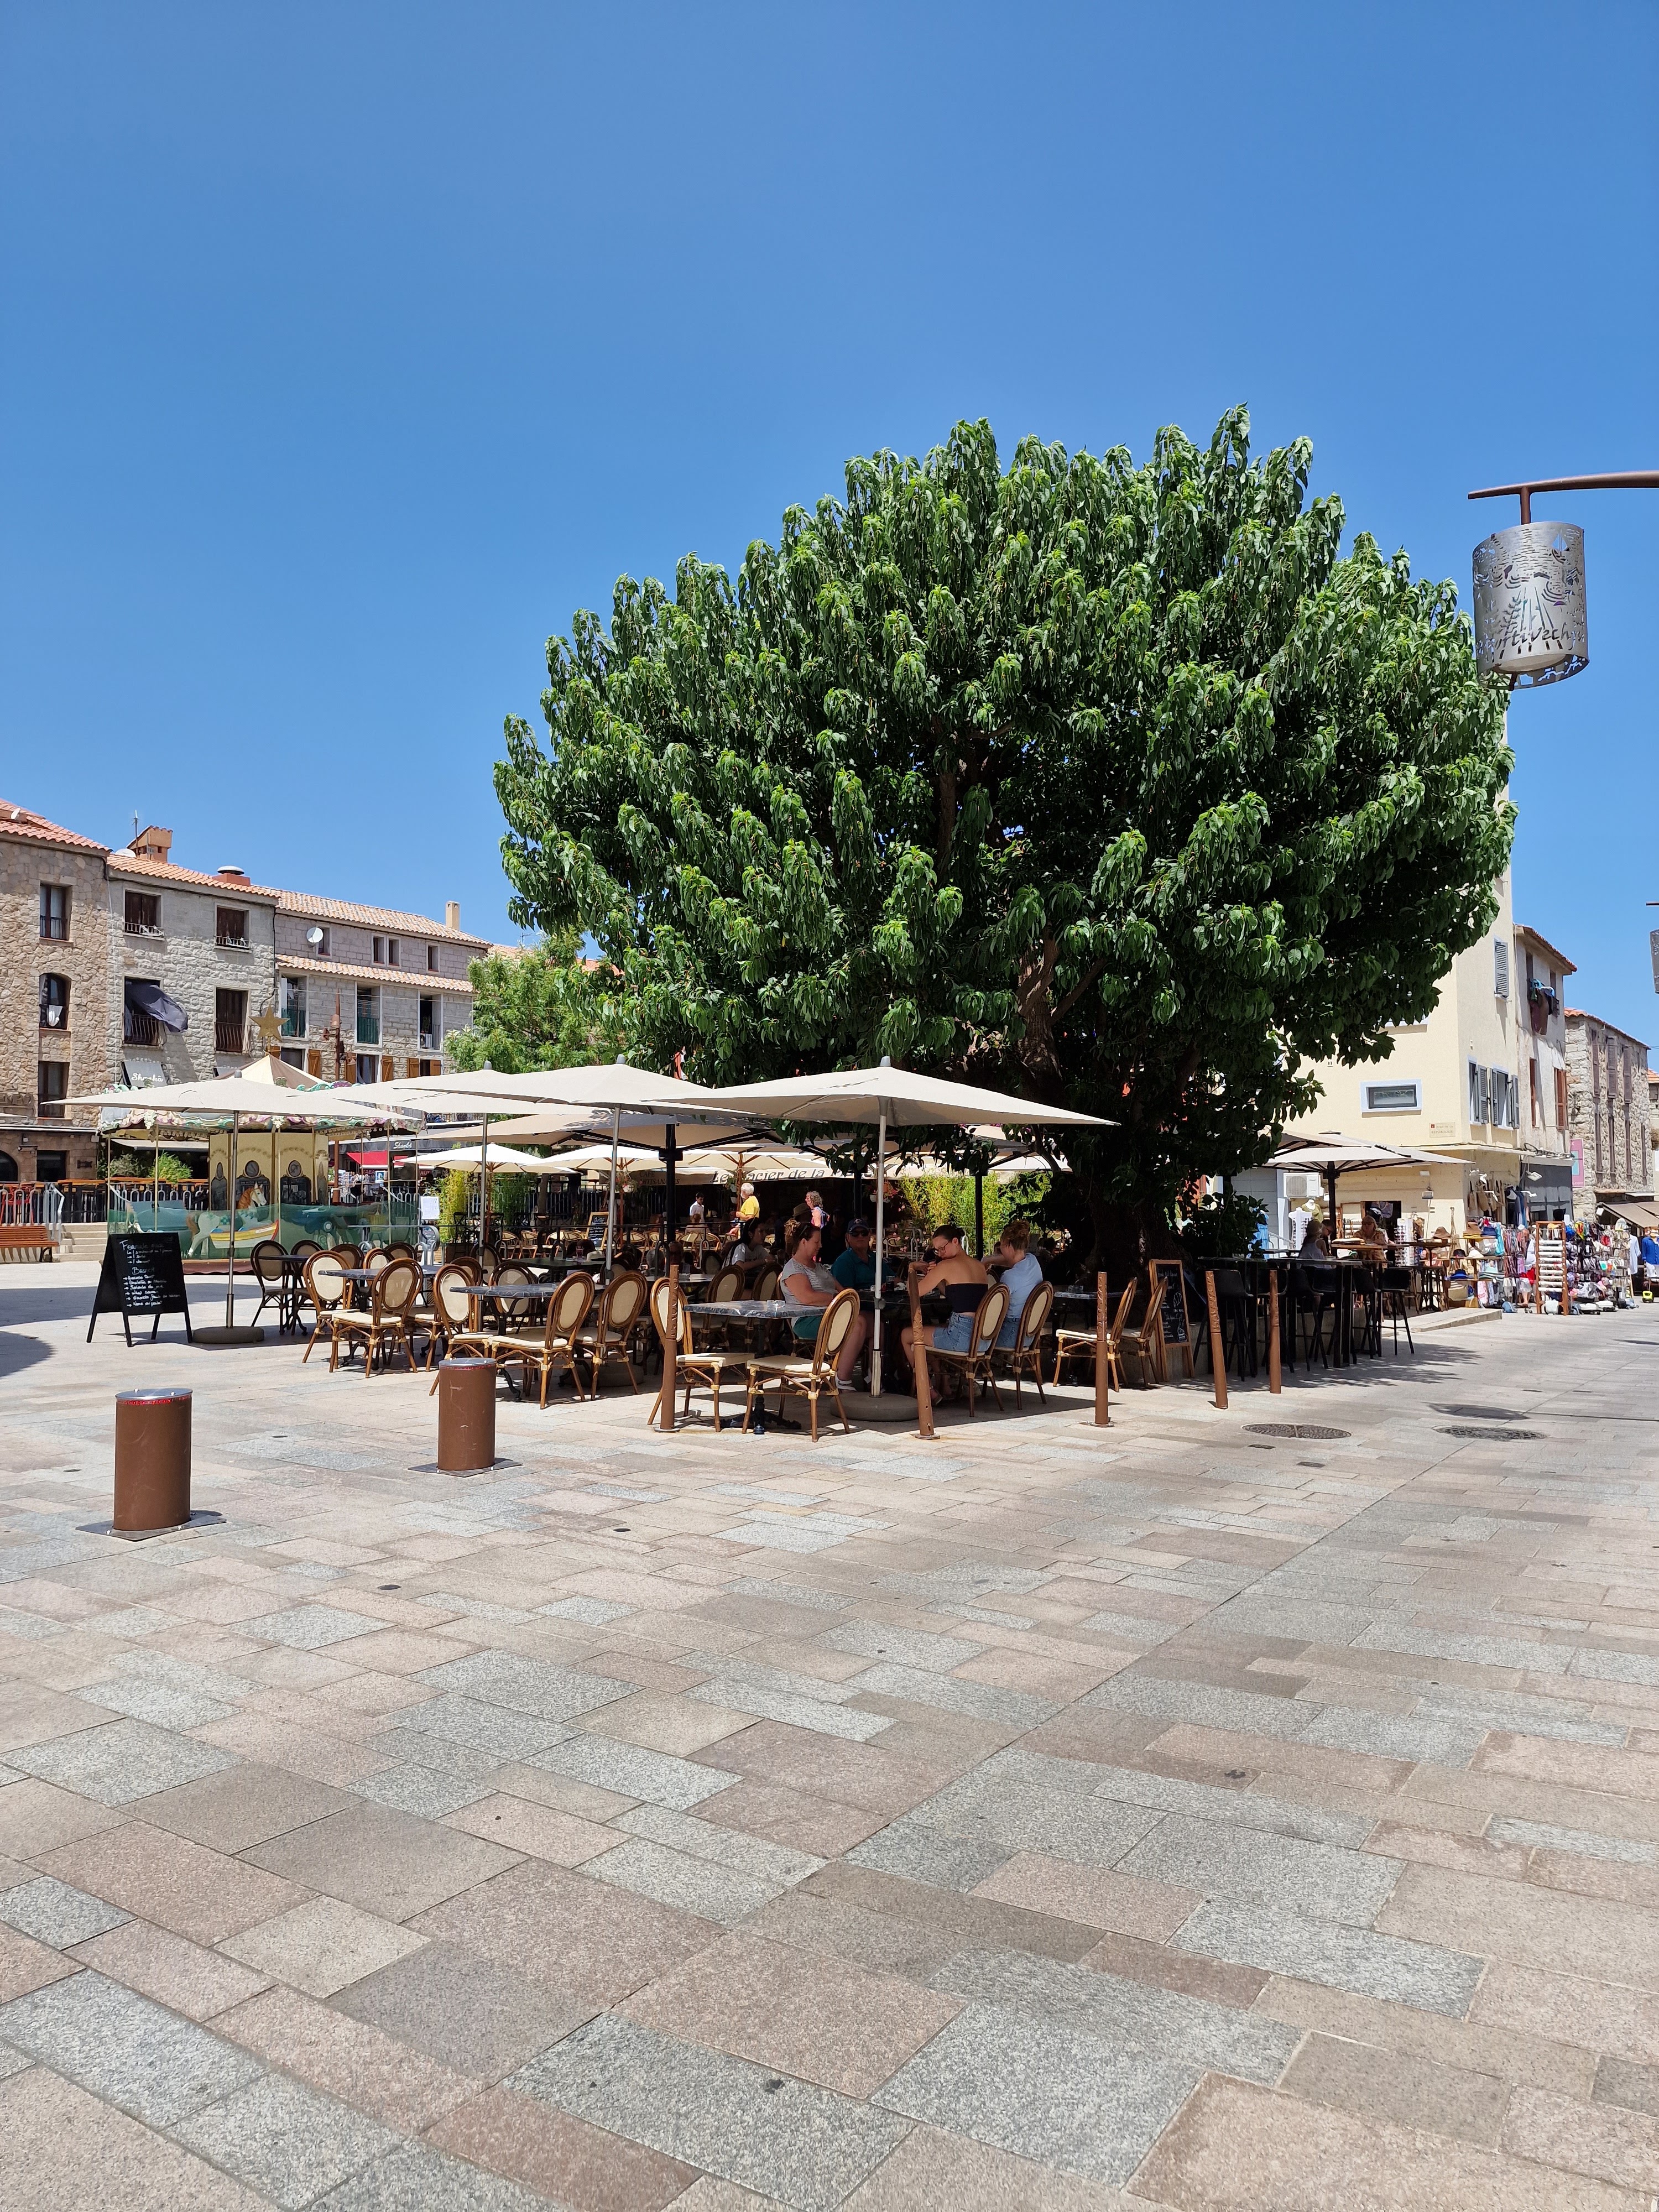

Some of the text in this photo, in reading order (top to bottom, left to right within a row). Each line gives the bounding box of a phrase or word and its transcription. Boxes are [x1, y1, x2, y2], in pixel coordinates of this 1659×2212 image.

[710, 1171, 729, 1183] Le
[789, 1169, 807, 1179] de
[811, 1168, 825, 1178] la
